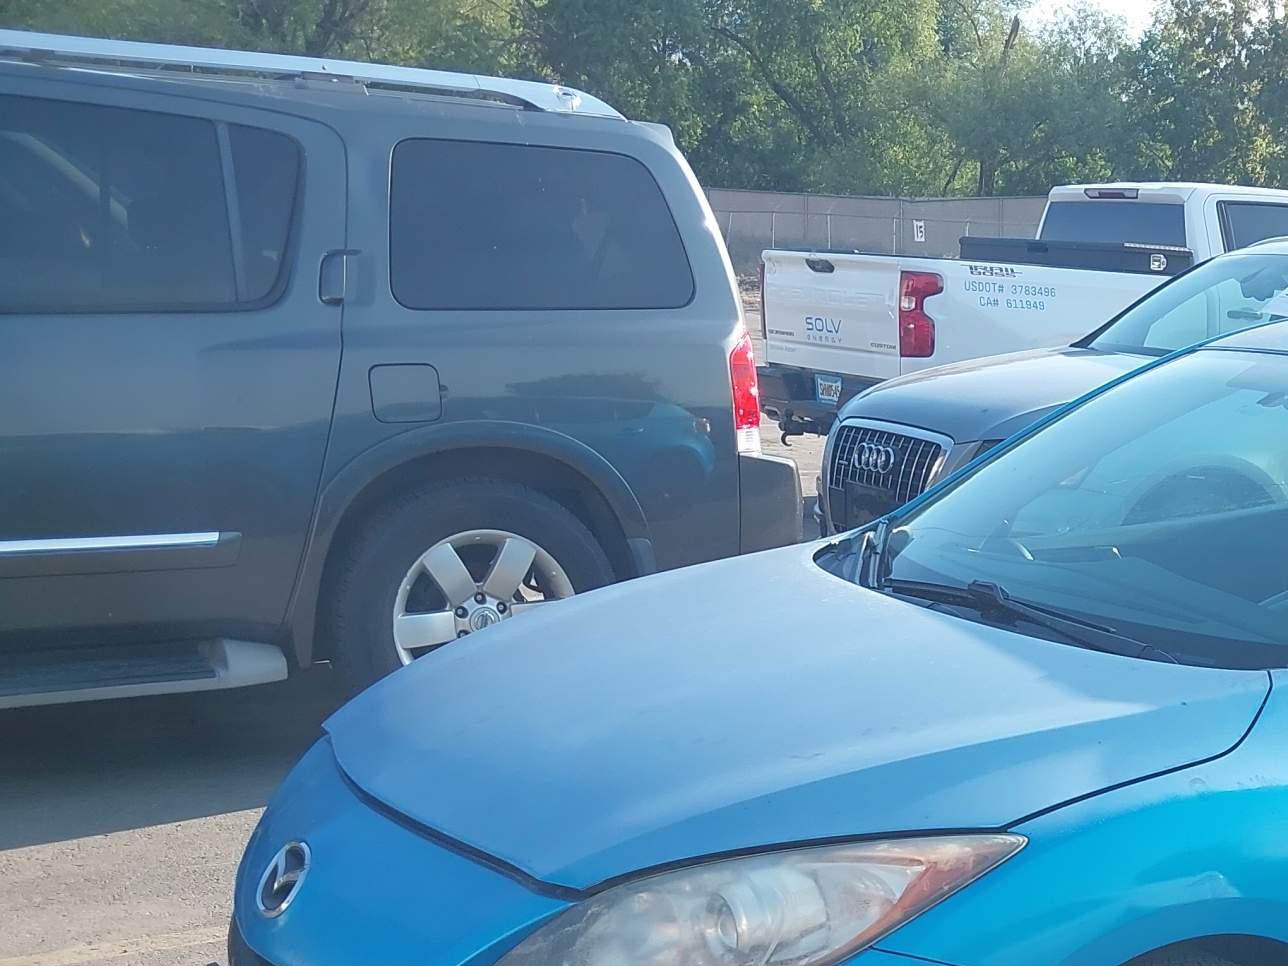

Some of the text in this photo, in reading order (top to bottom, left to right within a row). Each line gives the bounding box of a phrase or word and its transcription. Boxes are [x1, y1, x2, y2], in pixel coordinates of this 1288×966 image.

[964, 280, 1056, 297] USDOT# 3783496
[979, 296, 1045, 310] CA# 611949
[805, 316, 842, 334] SOLV
